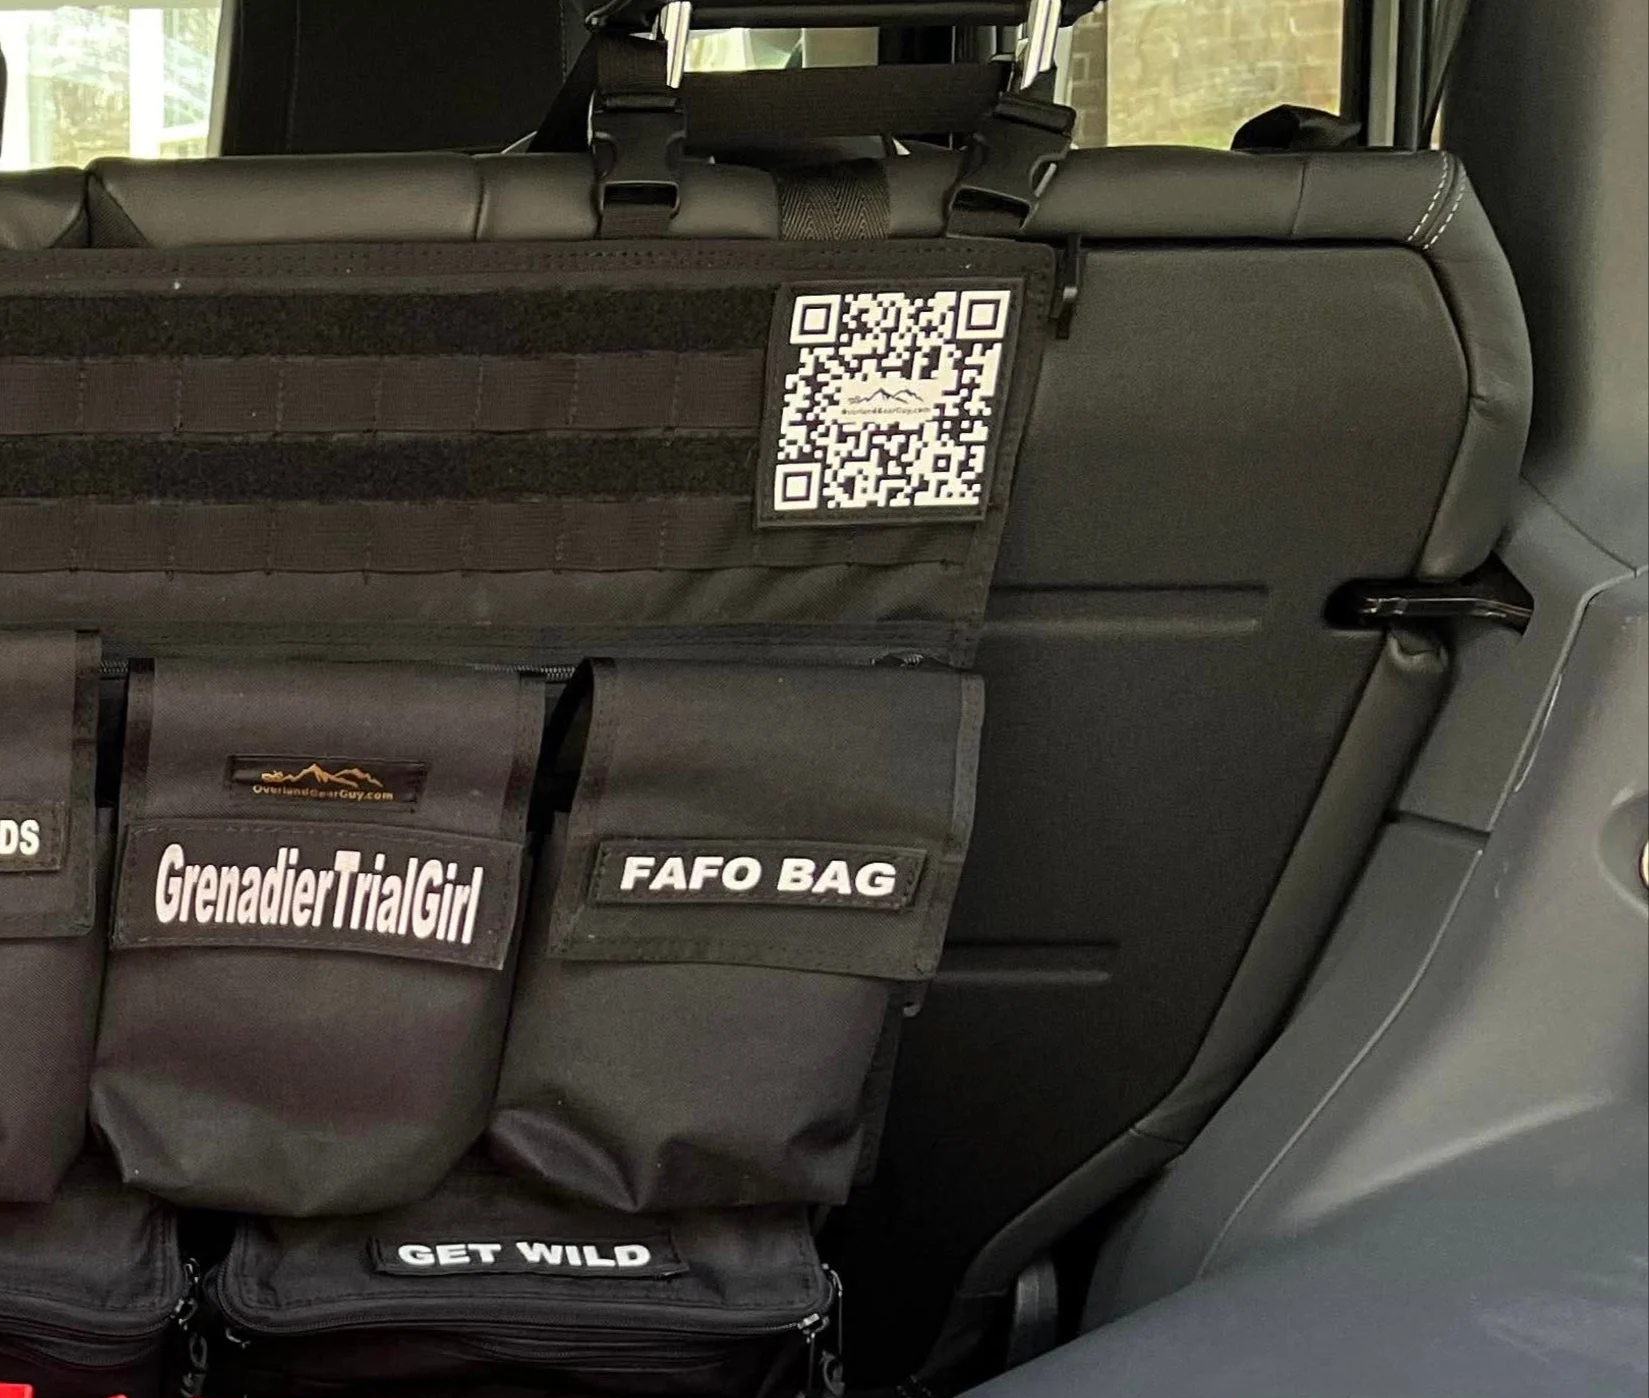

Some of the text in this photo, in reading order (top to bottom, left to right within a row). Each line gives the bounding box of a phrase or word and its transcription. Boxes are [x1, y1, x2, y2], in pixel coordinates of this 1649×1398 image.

[154, 843, 484, 945] GrenadierTrialGirl
[620, 856, 896, 896] FAFO BAG
[398, 1241, 651, 1267] GET WILD
